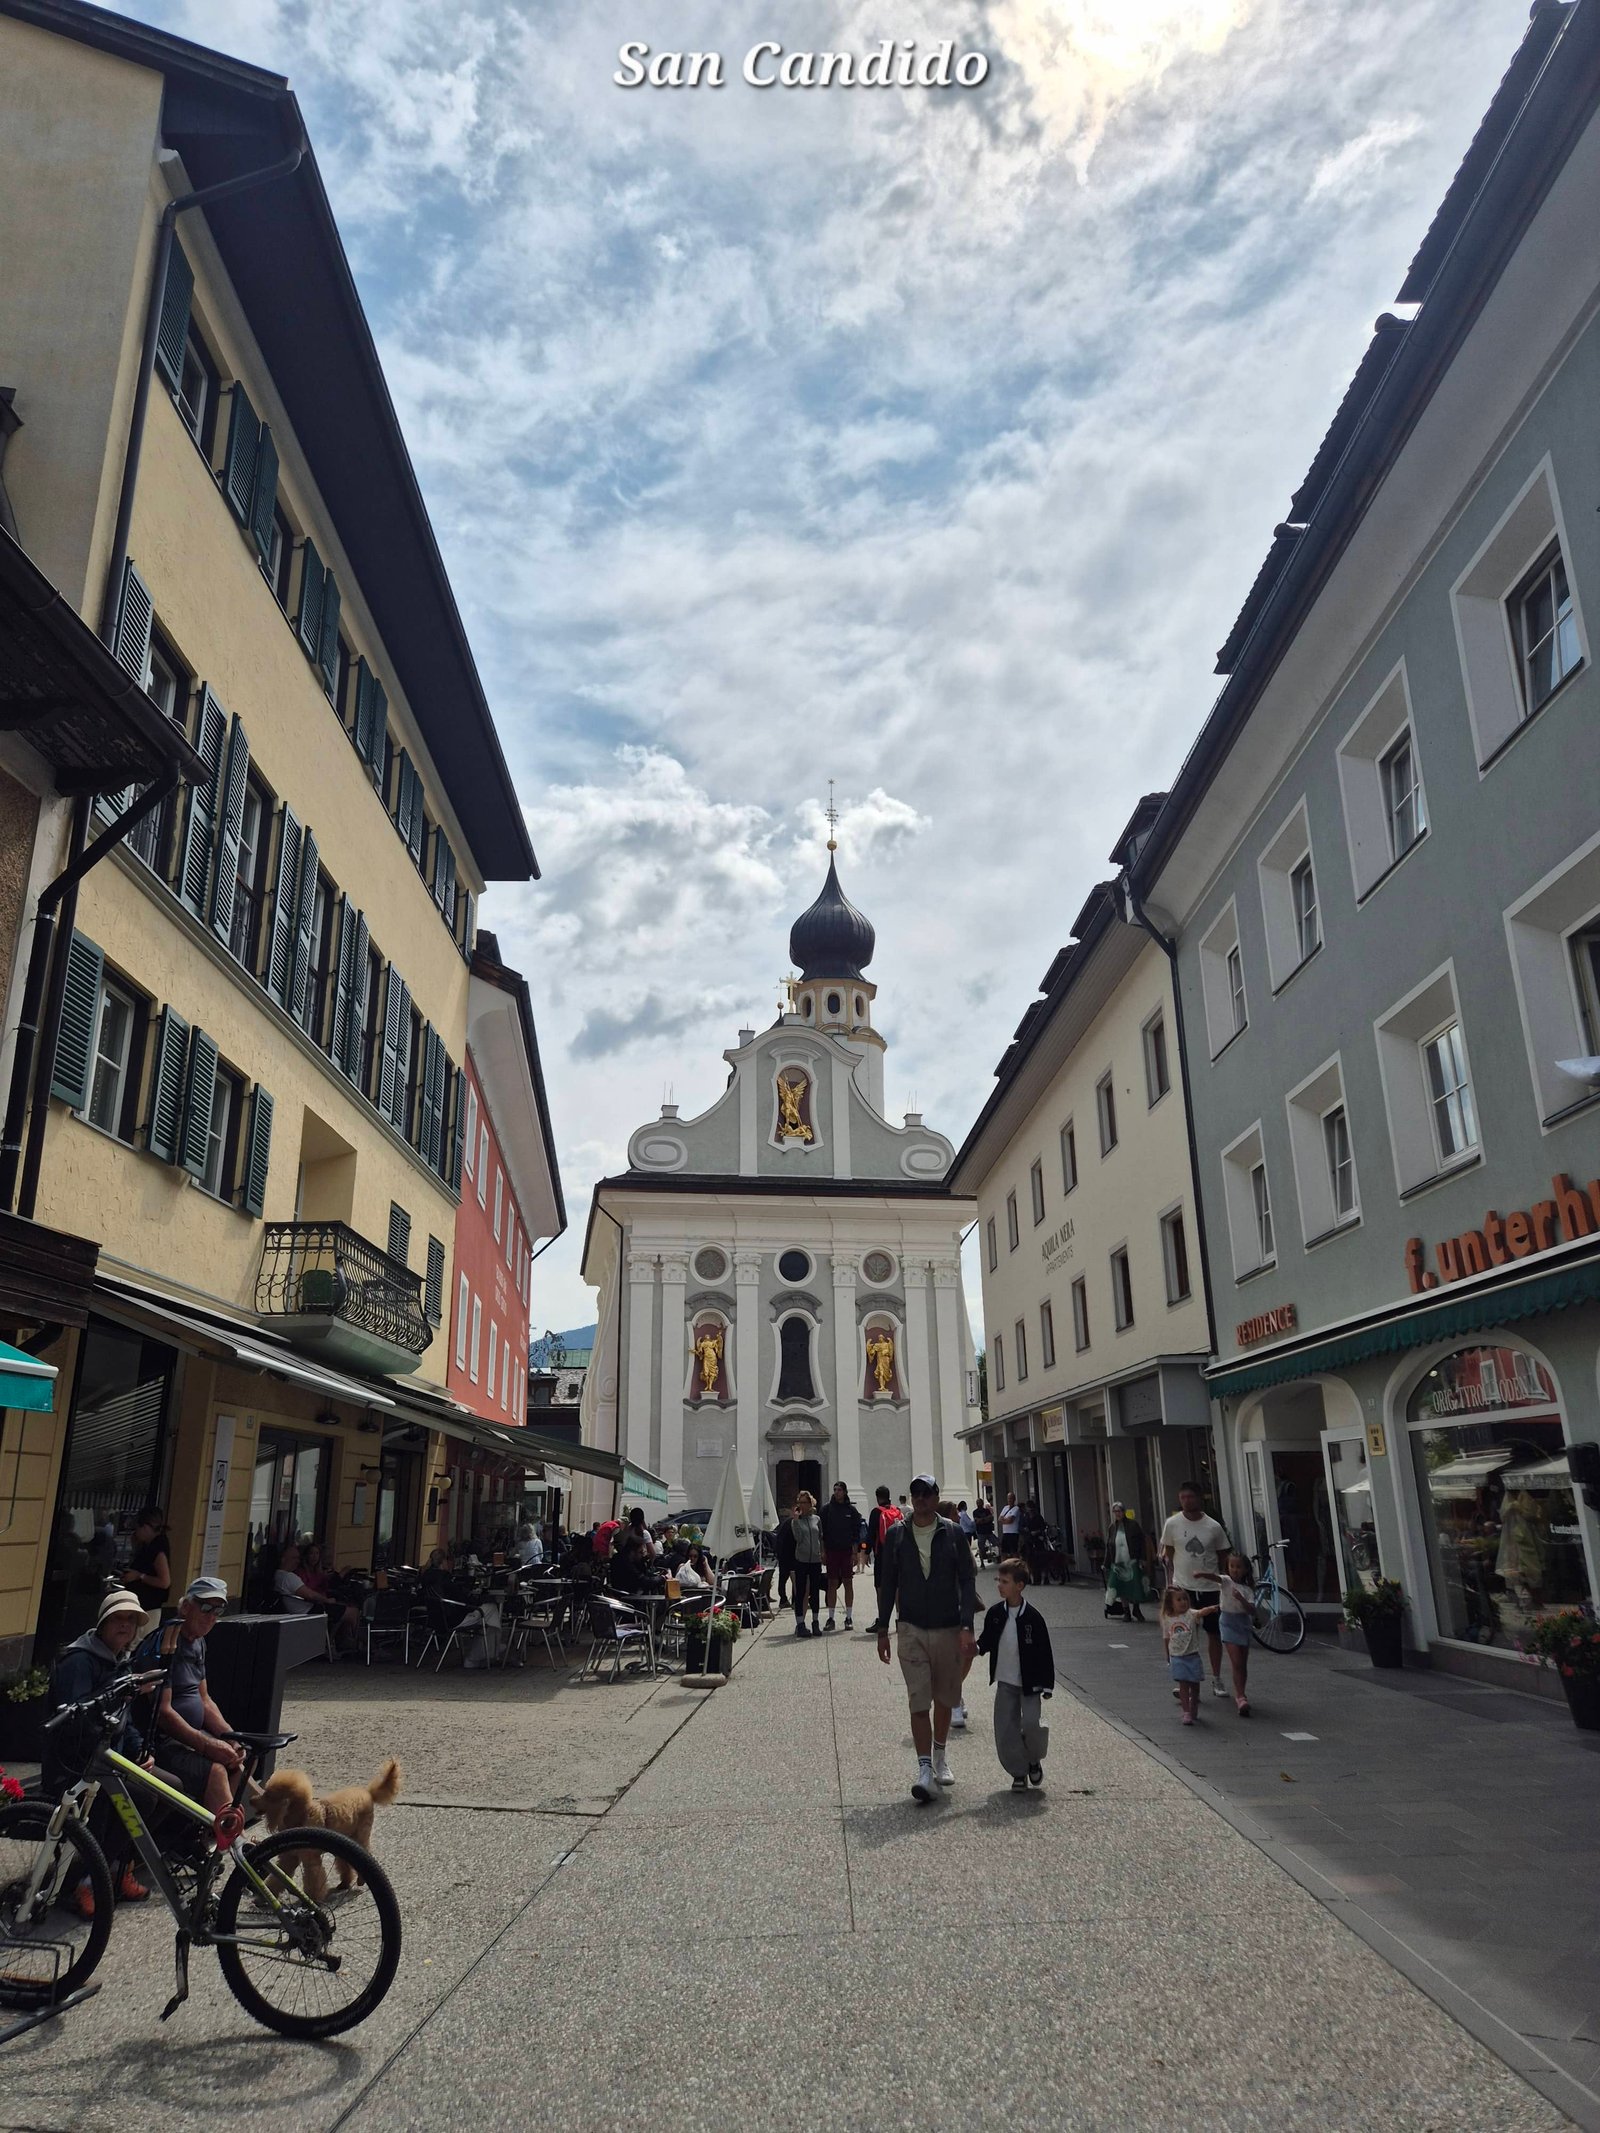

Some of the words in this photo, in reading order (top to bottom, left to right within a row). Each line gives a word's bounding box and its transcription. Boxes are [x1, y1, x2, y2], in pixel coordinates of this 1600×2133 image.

[1042, 1232, 1060, 1262] AQUILA
[1060, 1218, 1075, 1246] NERA
[1235, 1303, 1296, 1345] RESIDENCE
[111, 1793, 144, 1838] KTM
